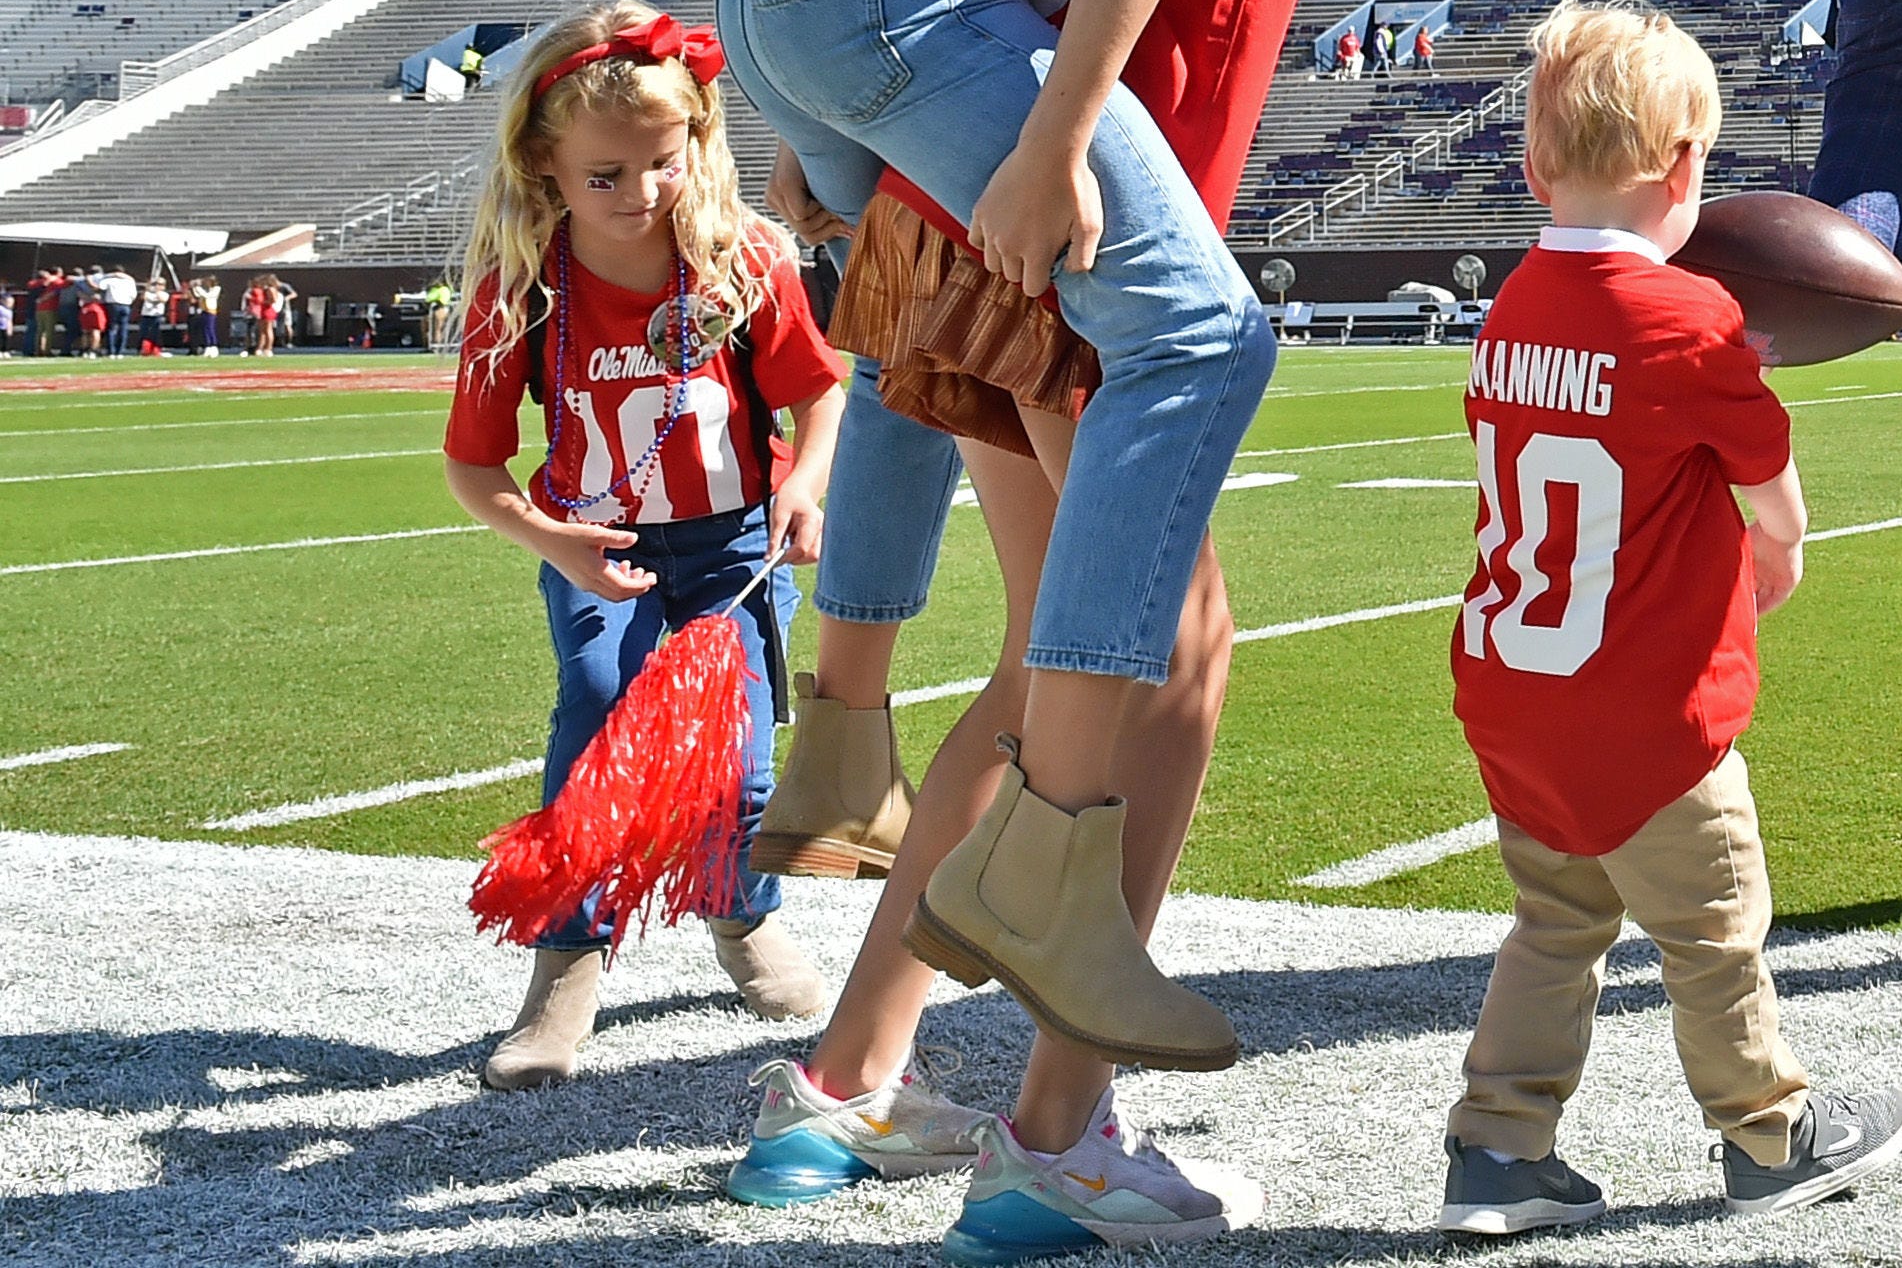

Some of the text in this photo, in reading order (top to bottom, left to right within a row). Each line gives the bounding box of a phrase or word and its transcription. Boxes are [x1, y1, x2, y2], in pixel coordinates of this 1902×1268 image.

[588, 346, 623, 382] Ole
[1468, 338, 1616, 417] MANNING
[564, 375, 746, 524] 10
[1463, 418, 1623, 676] 10
